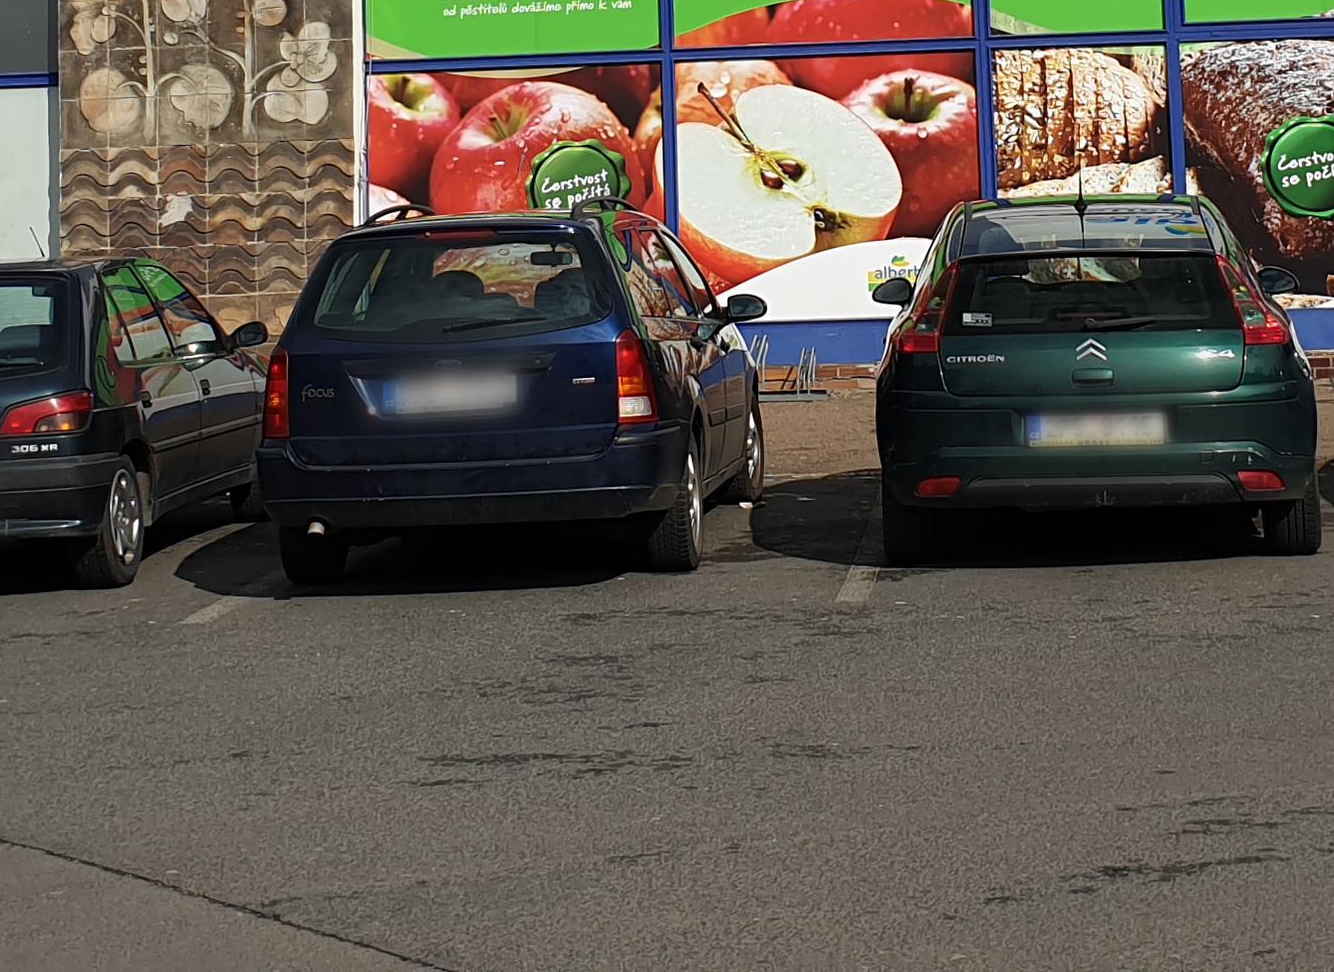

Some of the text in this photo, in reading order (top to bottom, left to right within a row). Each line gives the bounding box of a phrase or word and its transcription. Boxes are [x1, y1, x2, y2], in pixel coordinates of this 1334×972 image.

[443, 4, 456, 16] od
[460, 3, 508, 19] pěstitelů
[512, 2, 562, 14] dovážíme
[566, 0, 594, 15] přímo
[599, 0, 607, 10] k
[541, 169, 608, 193] Čerstvost
[1281, 174, 1301, 187] se
[545, 183, 611, 208] se počítá
[874, 265, 920, 279] albert
[947, 354, 1005, 363] CITROËN
[11, 443, 58, 453] 306 XR
